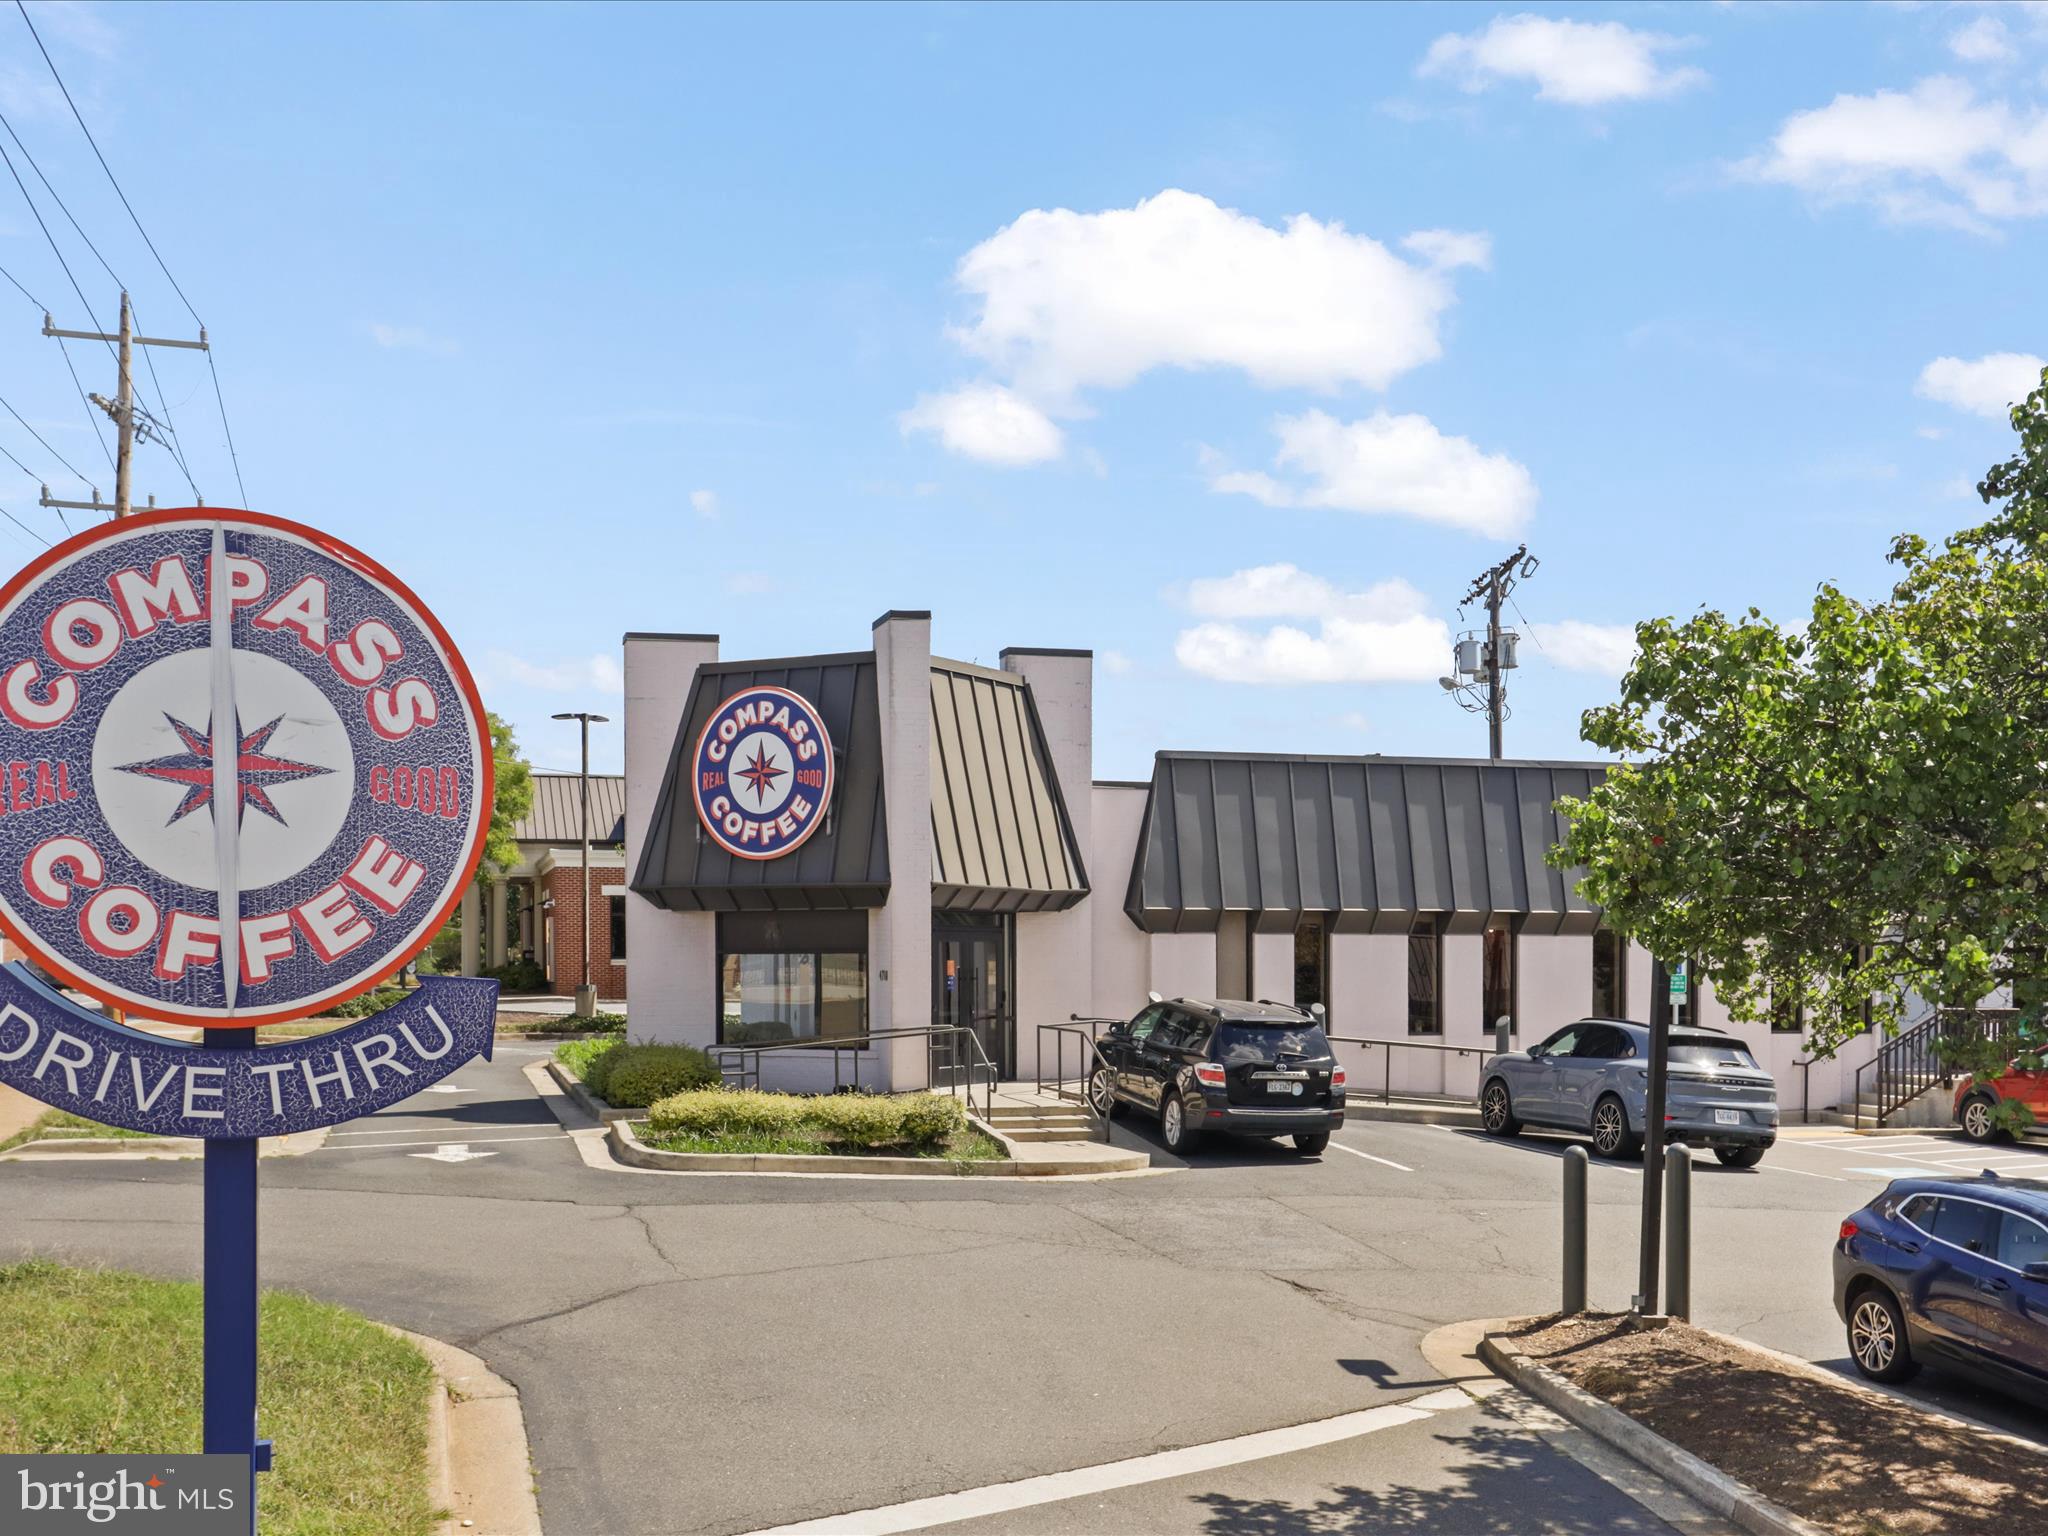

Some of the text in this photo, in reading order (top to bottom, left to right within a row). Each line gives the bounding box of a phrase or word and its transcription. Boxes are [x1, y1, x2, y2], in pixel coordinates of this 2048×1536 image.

[1, 552, 440, 741] COMPASS
[707, 701, 818, 763] COMPASS
[370, 765, 460, 819] GOOD
[702, 770, 822, 791] REAL GOOD
[710, 794, 812, 845] COFFEE
[22, 835, 427, 986] COFFEE
[0, 1002, 454, 1119] DRIVE THRU
